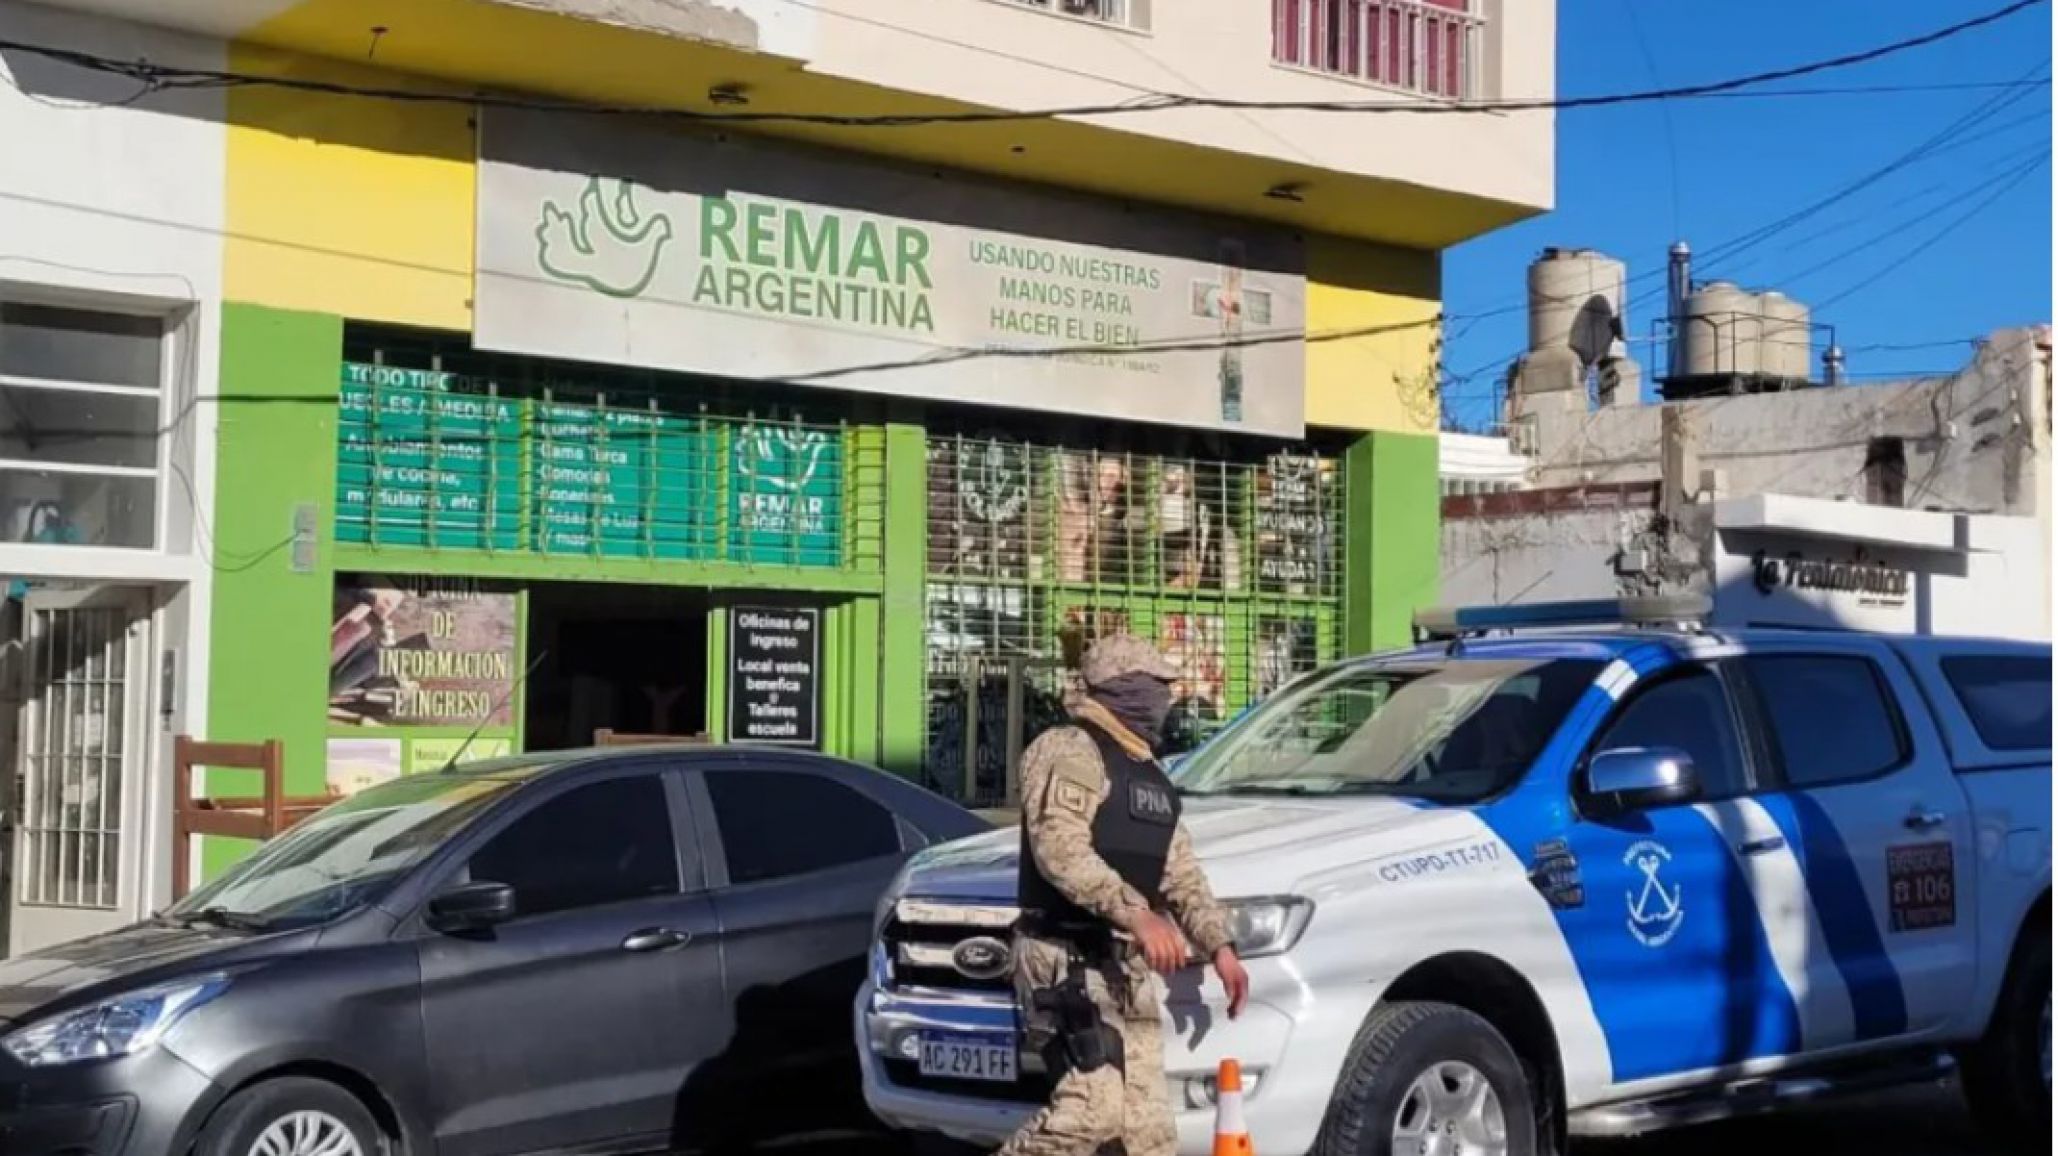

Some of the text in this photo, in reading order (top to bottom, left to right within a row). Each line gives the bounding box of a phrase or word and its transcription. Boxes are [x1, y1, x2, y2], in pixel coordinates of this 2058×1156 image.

[701, 195, 933, 288] REMAR
[969, 239, 1160, 289] USANDO NUESTRAS
[693, 264, 934, 332] ARGENTINA
[1000, 277, 1132, 315] MANOS PARA
[990, 306, 1139, 346] HACER EL BIEN
[432, 611, 457, 639] DE
[792, 616, 810, 631] de
[737, 657, 773, 673] Local
[411, 688, 490, 718] INGRESO
[1135, 786, 1172, 816] PNA
[1915, 873, 1951, 905] 106
[923, 1043, 1011, 1076] AC 291 FF
